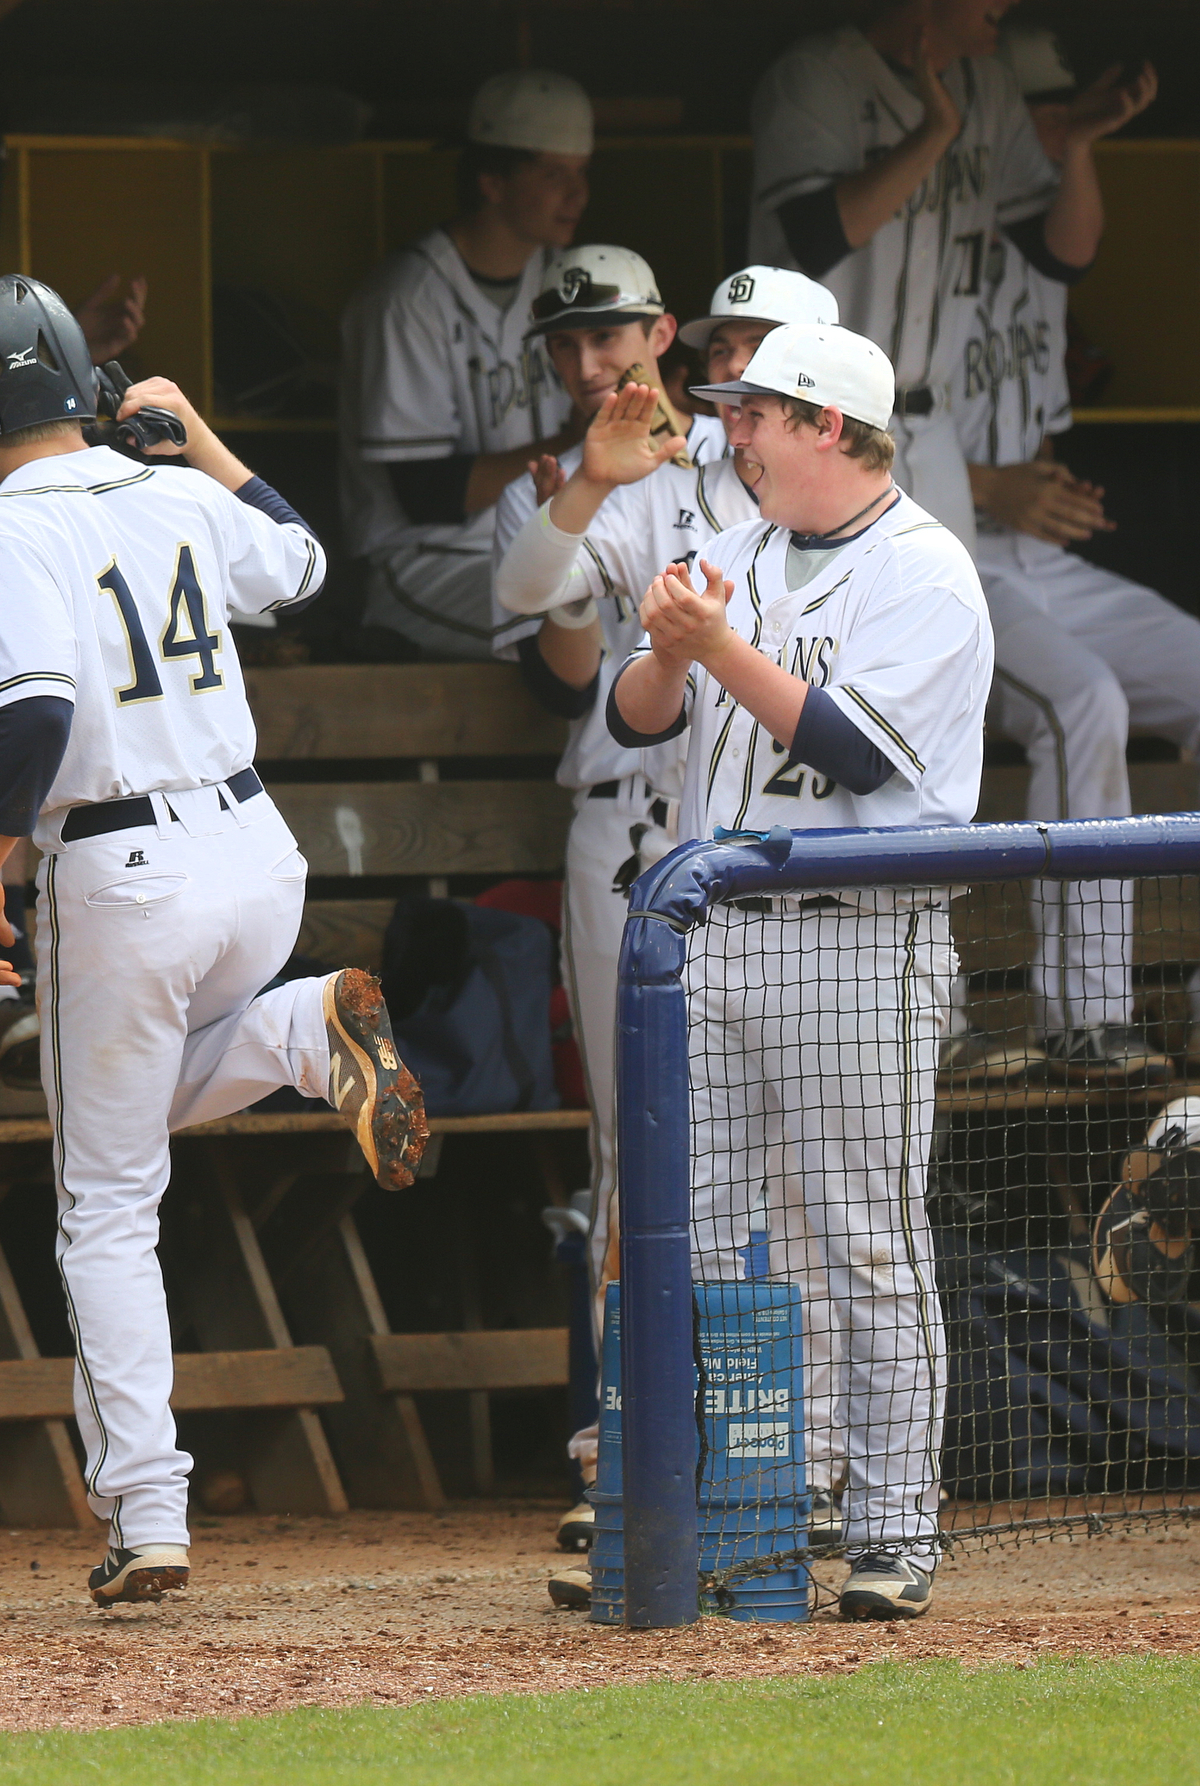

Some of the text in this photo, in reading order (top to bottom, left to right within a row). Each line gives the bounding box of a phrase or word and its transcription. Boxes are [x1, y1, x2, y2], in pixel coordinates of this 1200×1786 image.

[728, 273, 756, 304] SD
[94, 541, 226, 708] 14
[726, 1357, 757, 1370] Field
[705, 1388, 789, 1414] BRITE
[734, 1437, 785, 1451] Pioneer
